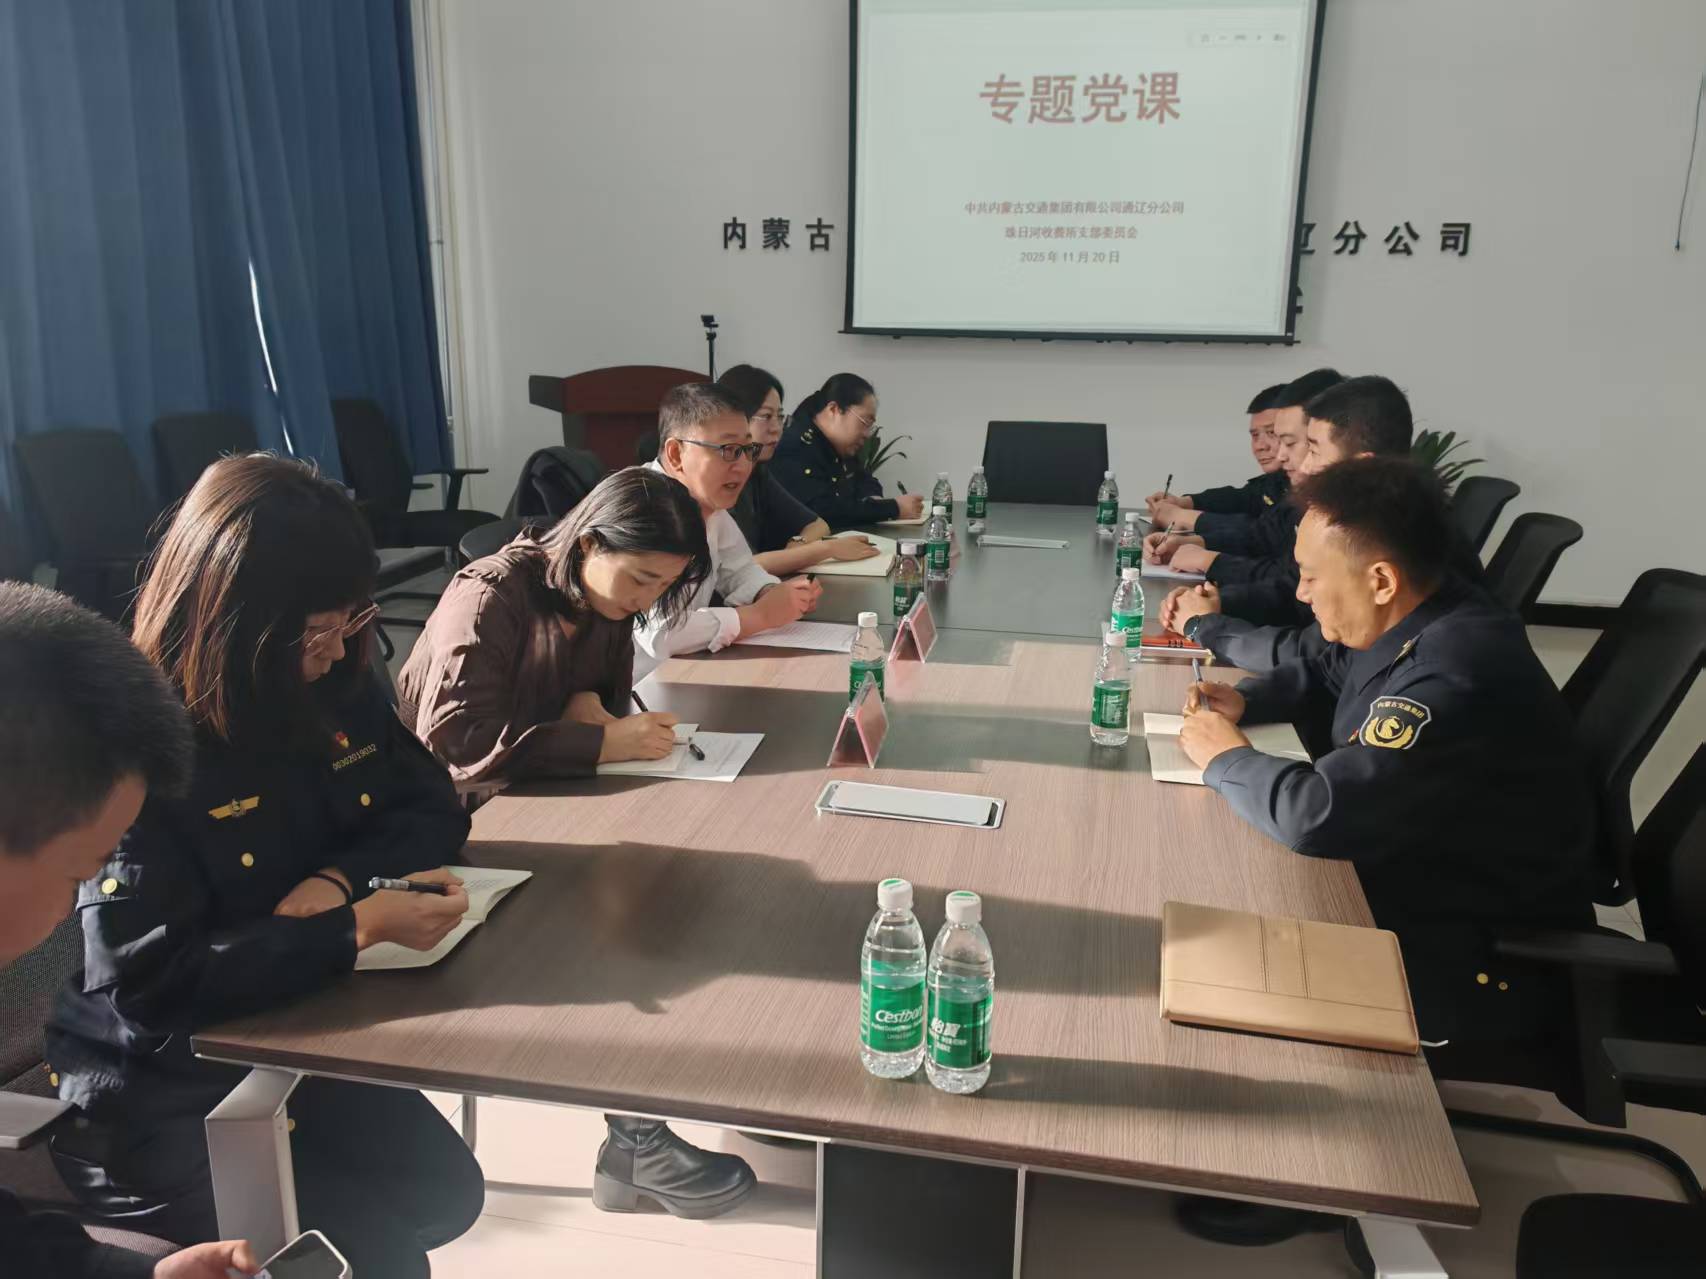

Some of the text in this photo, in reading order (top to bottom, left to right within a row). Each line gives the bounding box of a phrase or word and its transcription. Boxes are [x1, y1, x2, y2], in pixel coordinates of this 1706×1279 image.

[979, 72, 1181, 124] 专题党课
[723, 216, 835, 251] 内蒙古
